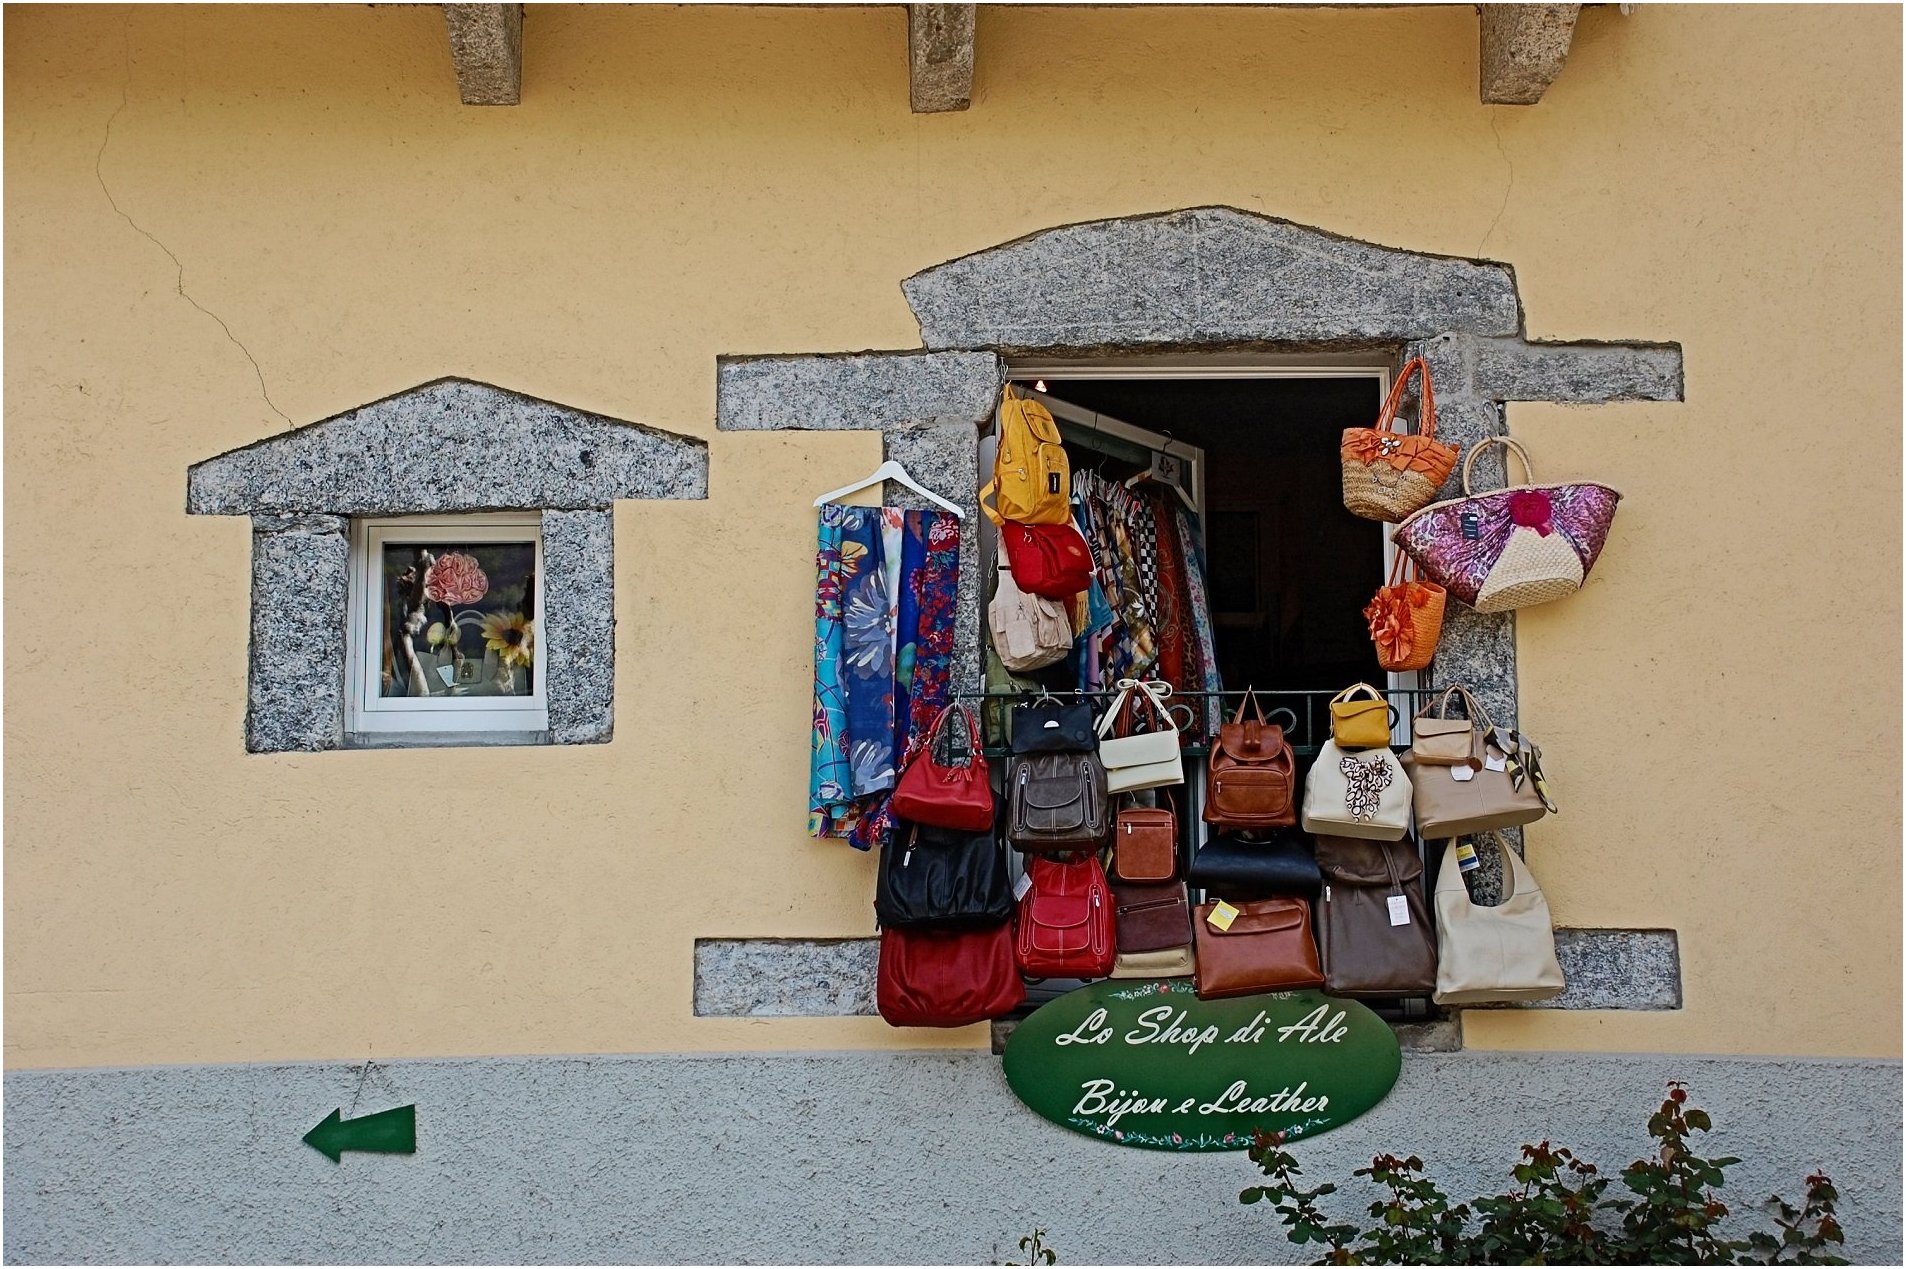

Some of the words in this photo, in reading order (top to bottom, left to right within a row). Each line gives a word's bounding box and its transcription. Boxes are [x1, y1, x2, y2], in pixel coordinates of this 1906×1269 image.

[1055, 1007, 1113, 1046] Lo
[1124, 1005, 1218, 1055] Shop
[1223, 1010, 1271, 1044] di
[1277, 1003, 1349, 1043] Ale
[1072, 1078, 1167, 1127] Bijou
[1171, 1097, 1195, 1115] e
[1198, 1079, 1330, 1115] Leather
